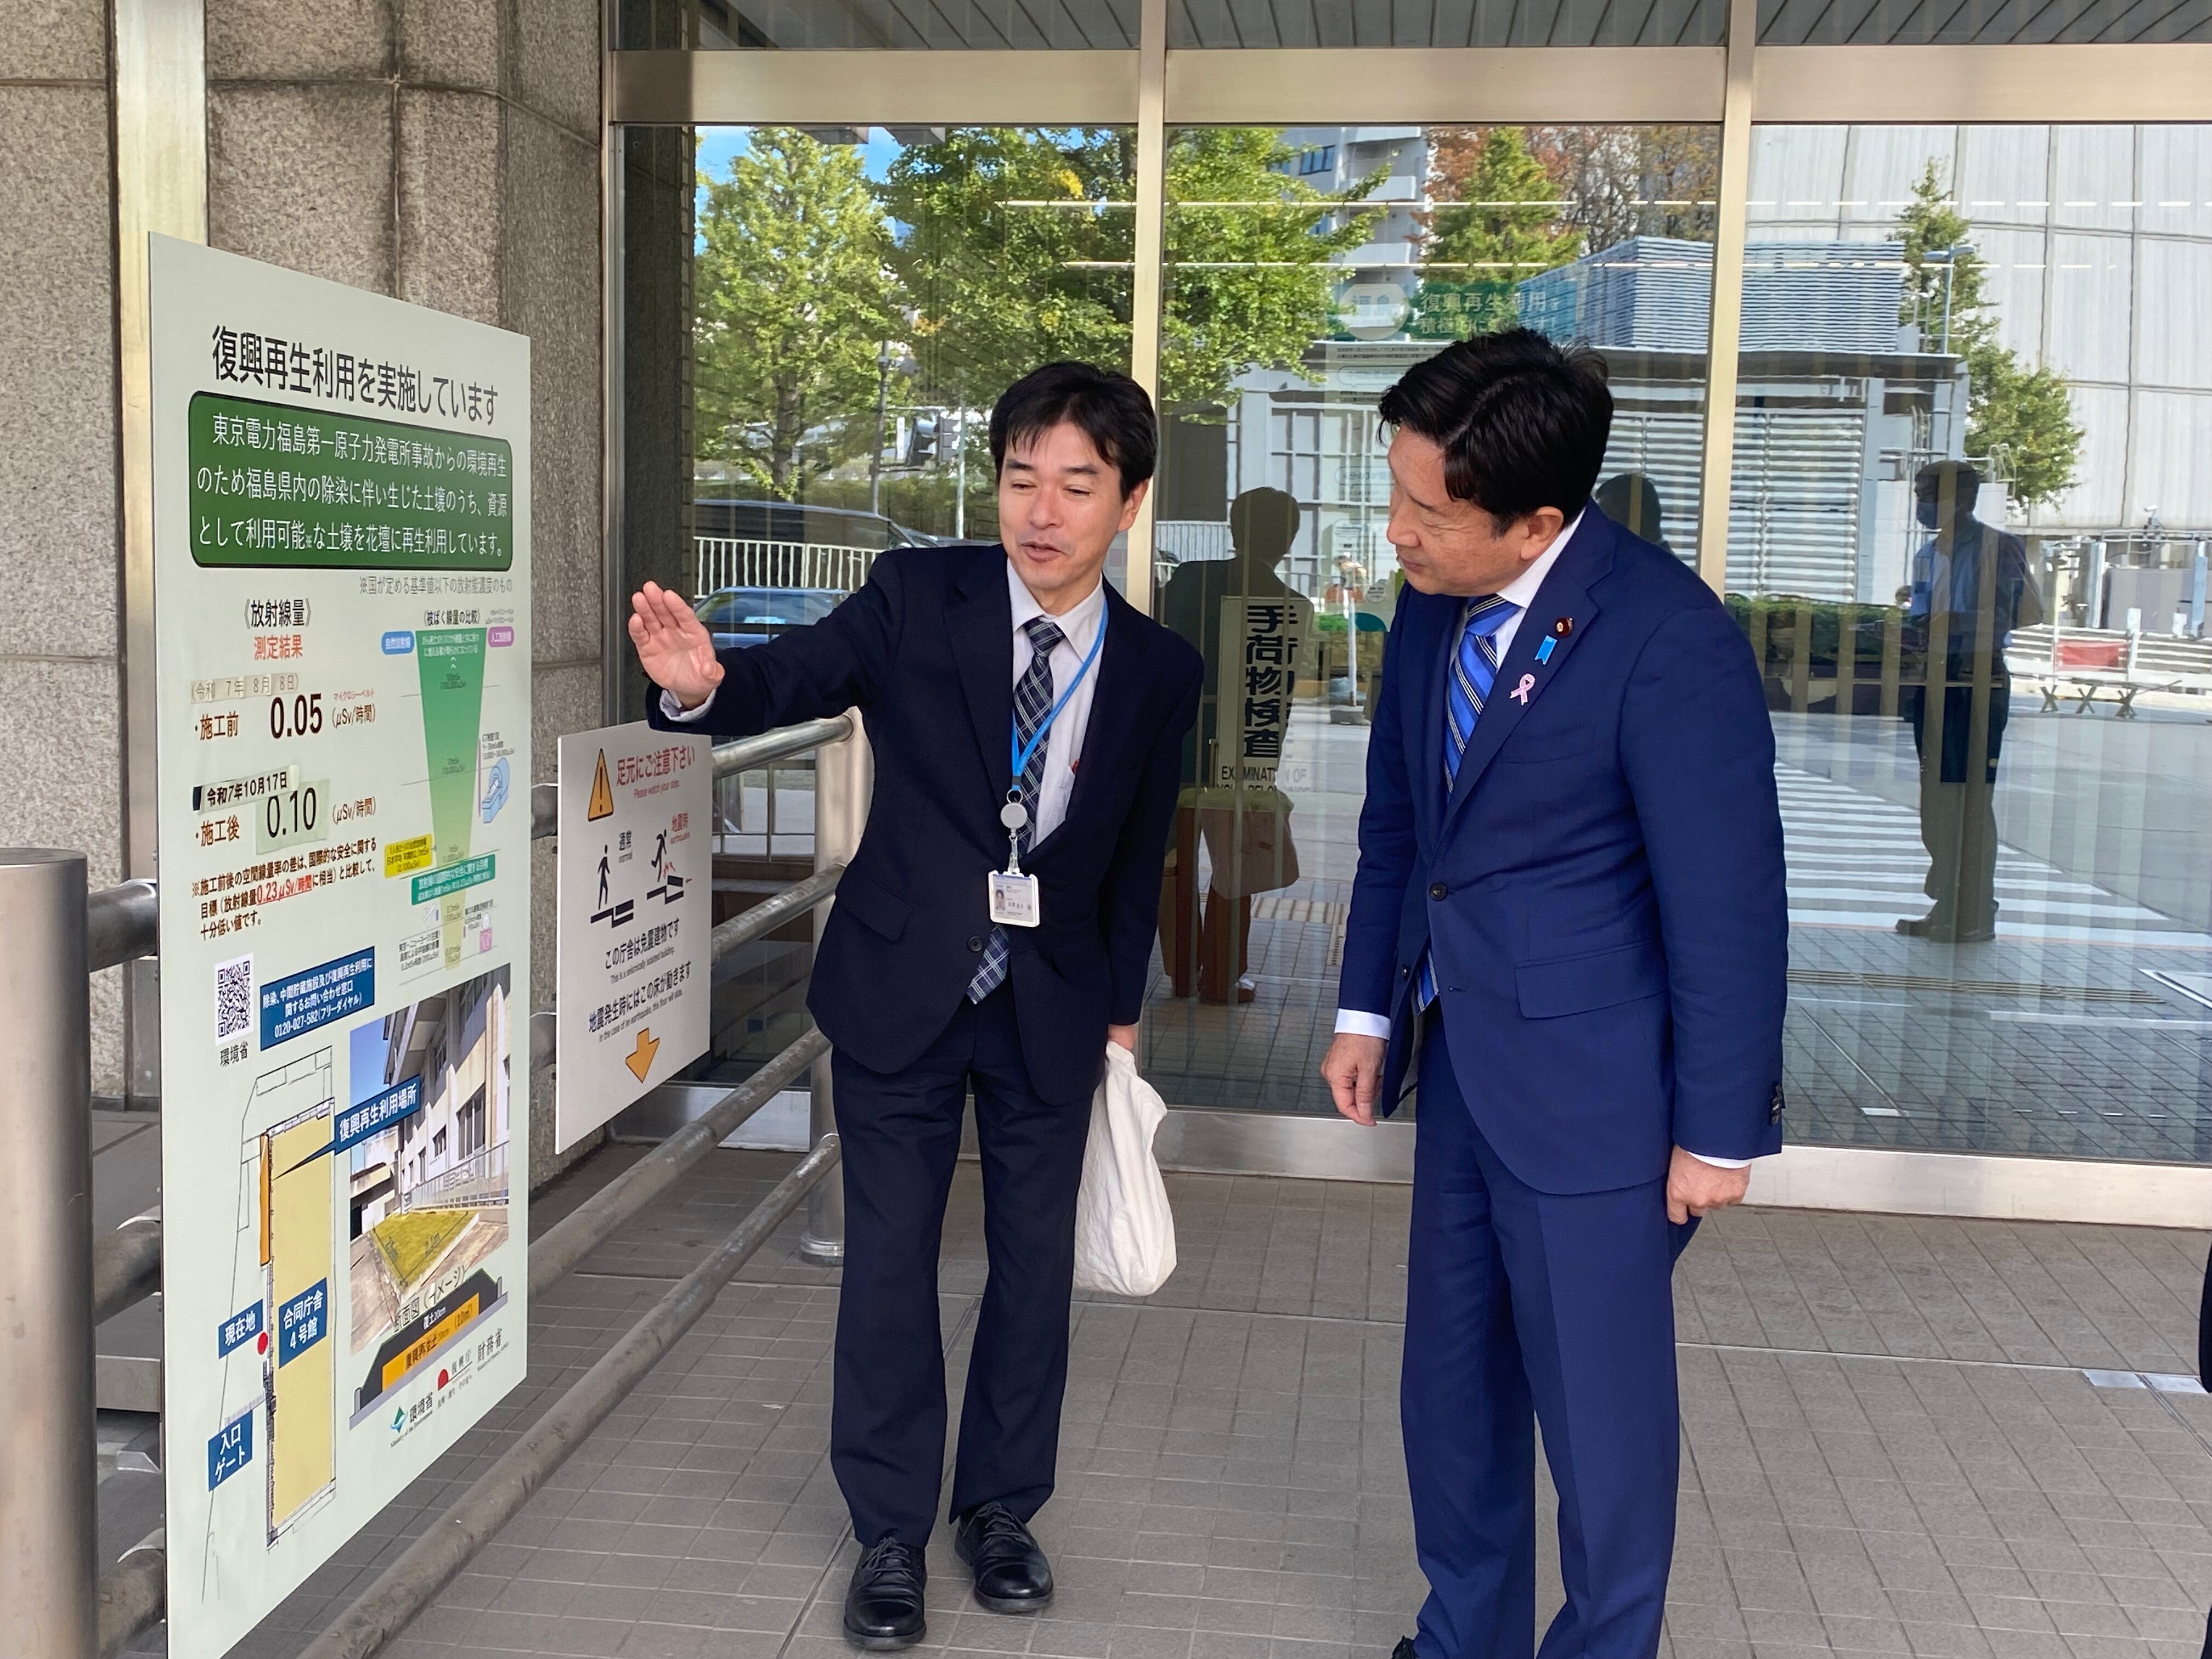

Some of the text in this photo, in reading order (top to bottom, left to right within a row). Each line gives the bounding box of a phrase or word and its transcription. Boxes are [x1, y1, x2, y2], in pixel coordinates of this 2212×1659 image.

[212, 325, 499, 426] 復興再生利用を実施しています
[212, 413, 507, 479] 東京電力福島第一原子力発電所事故からの環境再生
[197, 465, 507, 518] のため福島県内の除染に伴い生じた土壌のうち、資源
[254, 634, 303, 660] 測定結果
[1243, 605, 1298, 758] 手荷物検査
[270, 692, 323, 739] 0.05
[616, 744, 695, 787] 足元にご注意下さい
[207, 771, 287, 807] 令和7年10月17日
[267, 787, 317, 838] 0.10
[200, 909, 262, 942] 十分低い値です。
[220, 1040, 249, 1067] 環境省
[340, 1082, 417, 1143] 復興再生利用場所
[225, 1310, 256, 1347] 現在地
[283, 1289, 324, 1331] 合同庁舎
[290, 1316, 318, 1350] 4号館
[478, 1328, 503, 1363] 財務省
[410, 1392, 433, 1423] 環境省
[220, 1424, 241, 1455] 入口
[215, 1445, 245, 1482] ゲート
